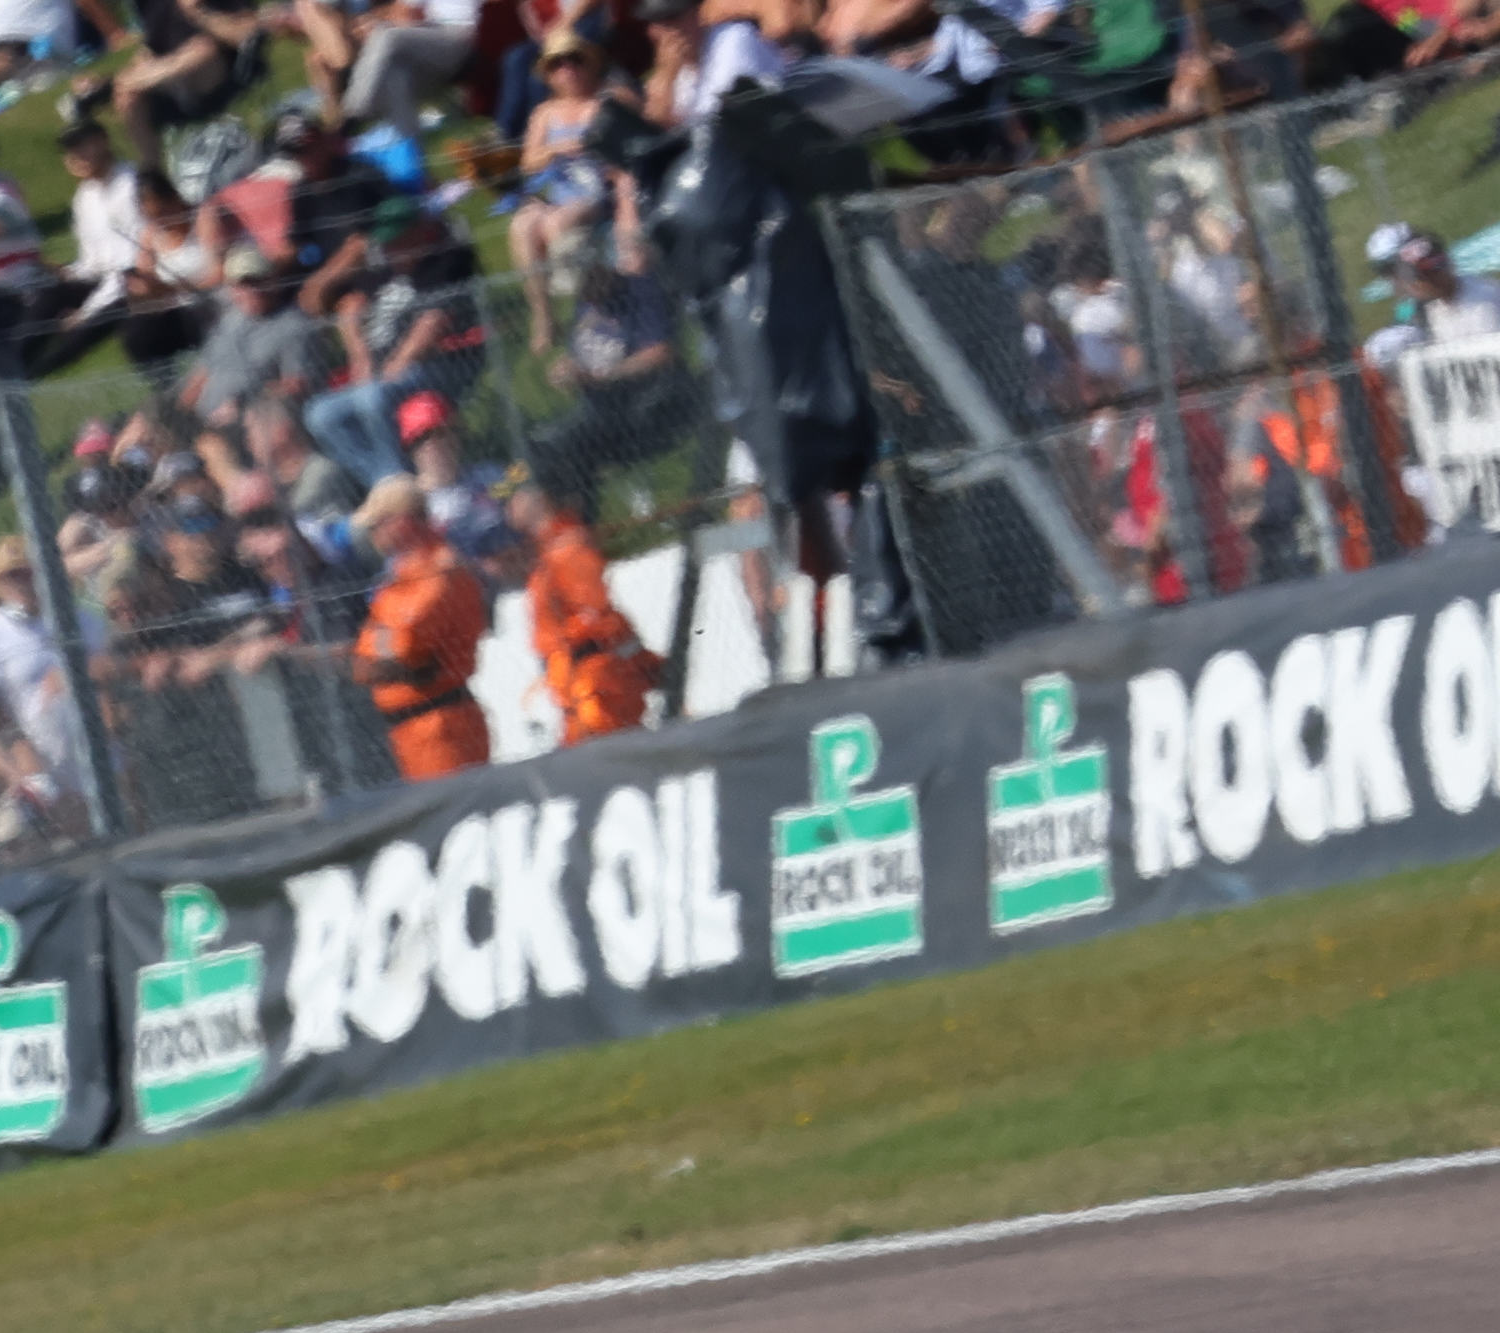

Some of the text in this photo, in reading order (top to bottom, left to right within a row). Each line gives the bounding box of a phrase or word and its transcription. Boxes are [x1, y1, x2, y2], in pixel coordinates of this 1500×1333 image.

[1128, 598, 1500, 880] ROCK O
[282, 770, 743, 1063] ROCK OIL
